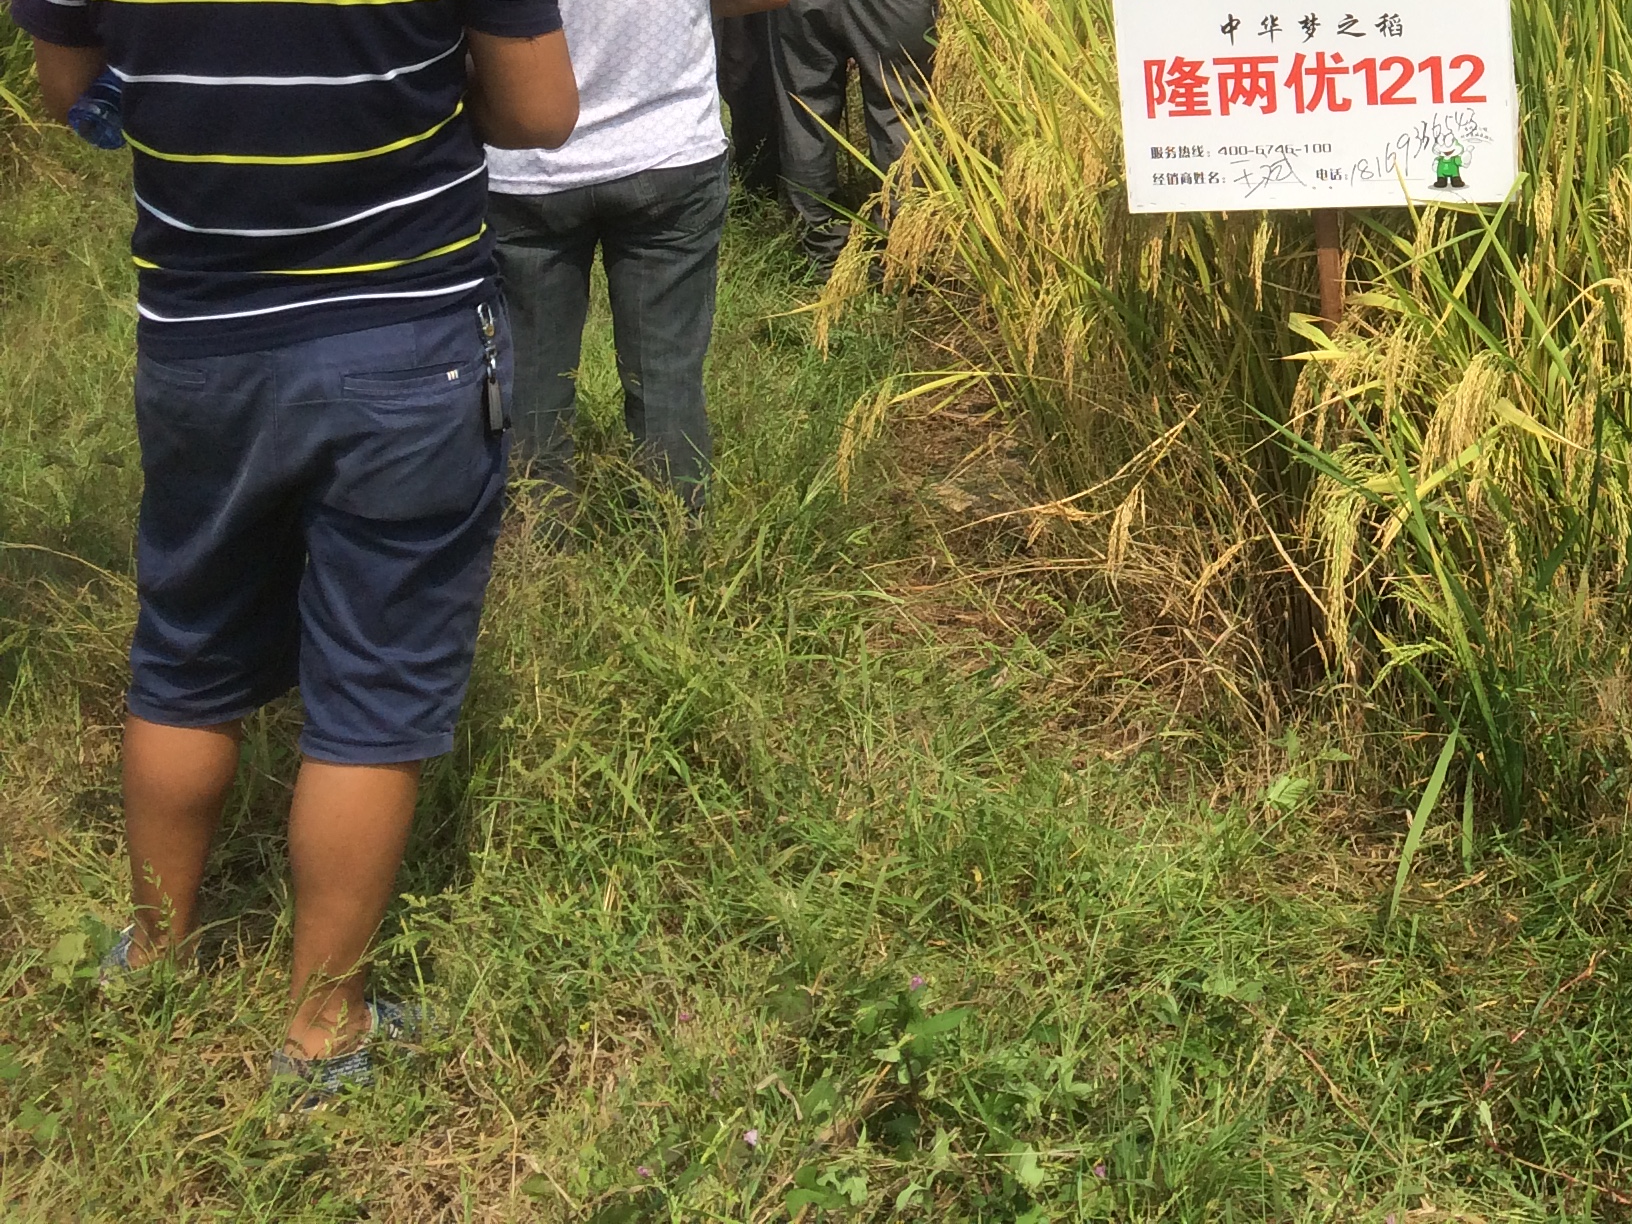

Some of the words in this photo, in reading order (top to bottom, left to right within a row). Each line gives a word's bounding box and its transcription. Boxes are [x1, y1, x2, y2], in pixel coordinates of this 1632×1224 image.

[1220, 13, 1404, 46] 中华梦之稻
[1144, 52, 1487, 119] 隆两优1212
